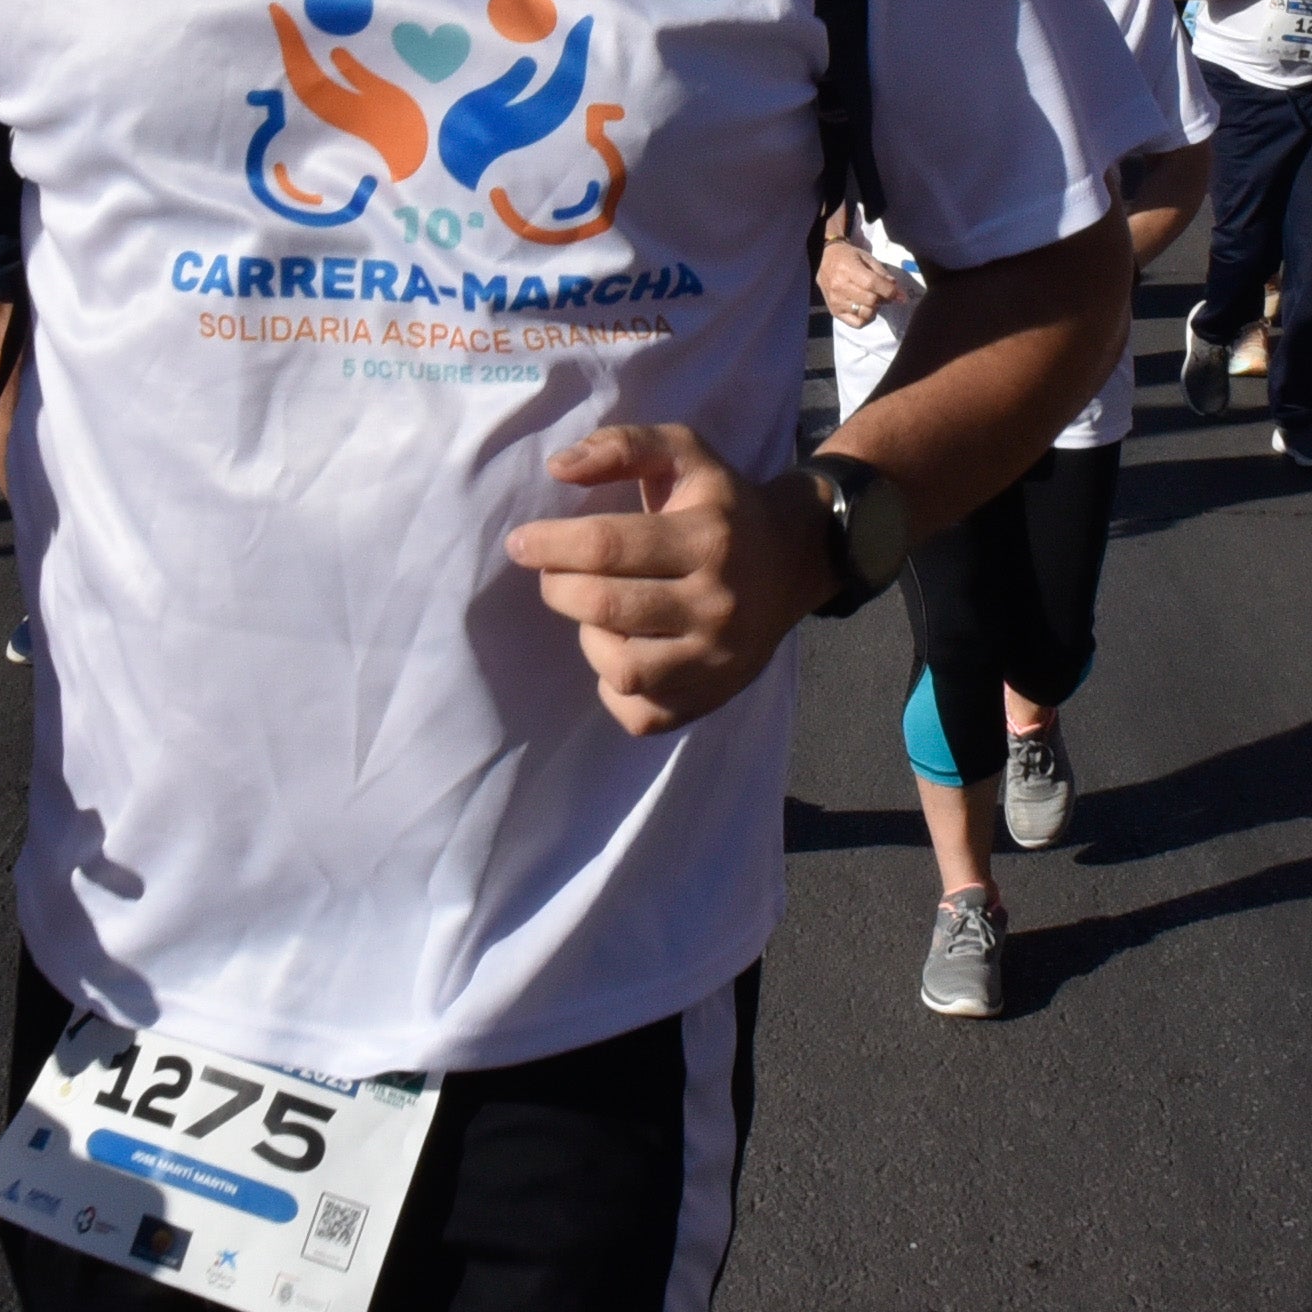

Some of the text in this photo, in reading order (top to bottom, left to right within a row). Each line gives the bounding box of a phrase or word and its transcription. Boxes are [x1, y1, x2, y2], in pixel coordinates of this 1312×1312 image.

[172, 251, 705, 313] CARRERA-MARCHA
[199, 311, 674, 355] SOLIDARIA ASPACE GRANADA
[342, 359, 541, 384] 5 OCTUBRE 2025
[93, 1043, 338, 1174] 1275
